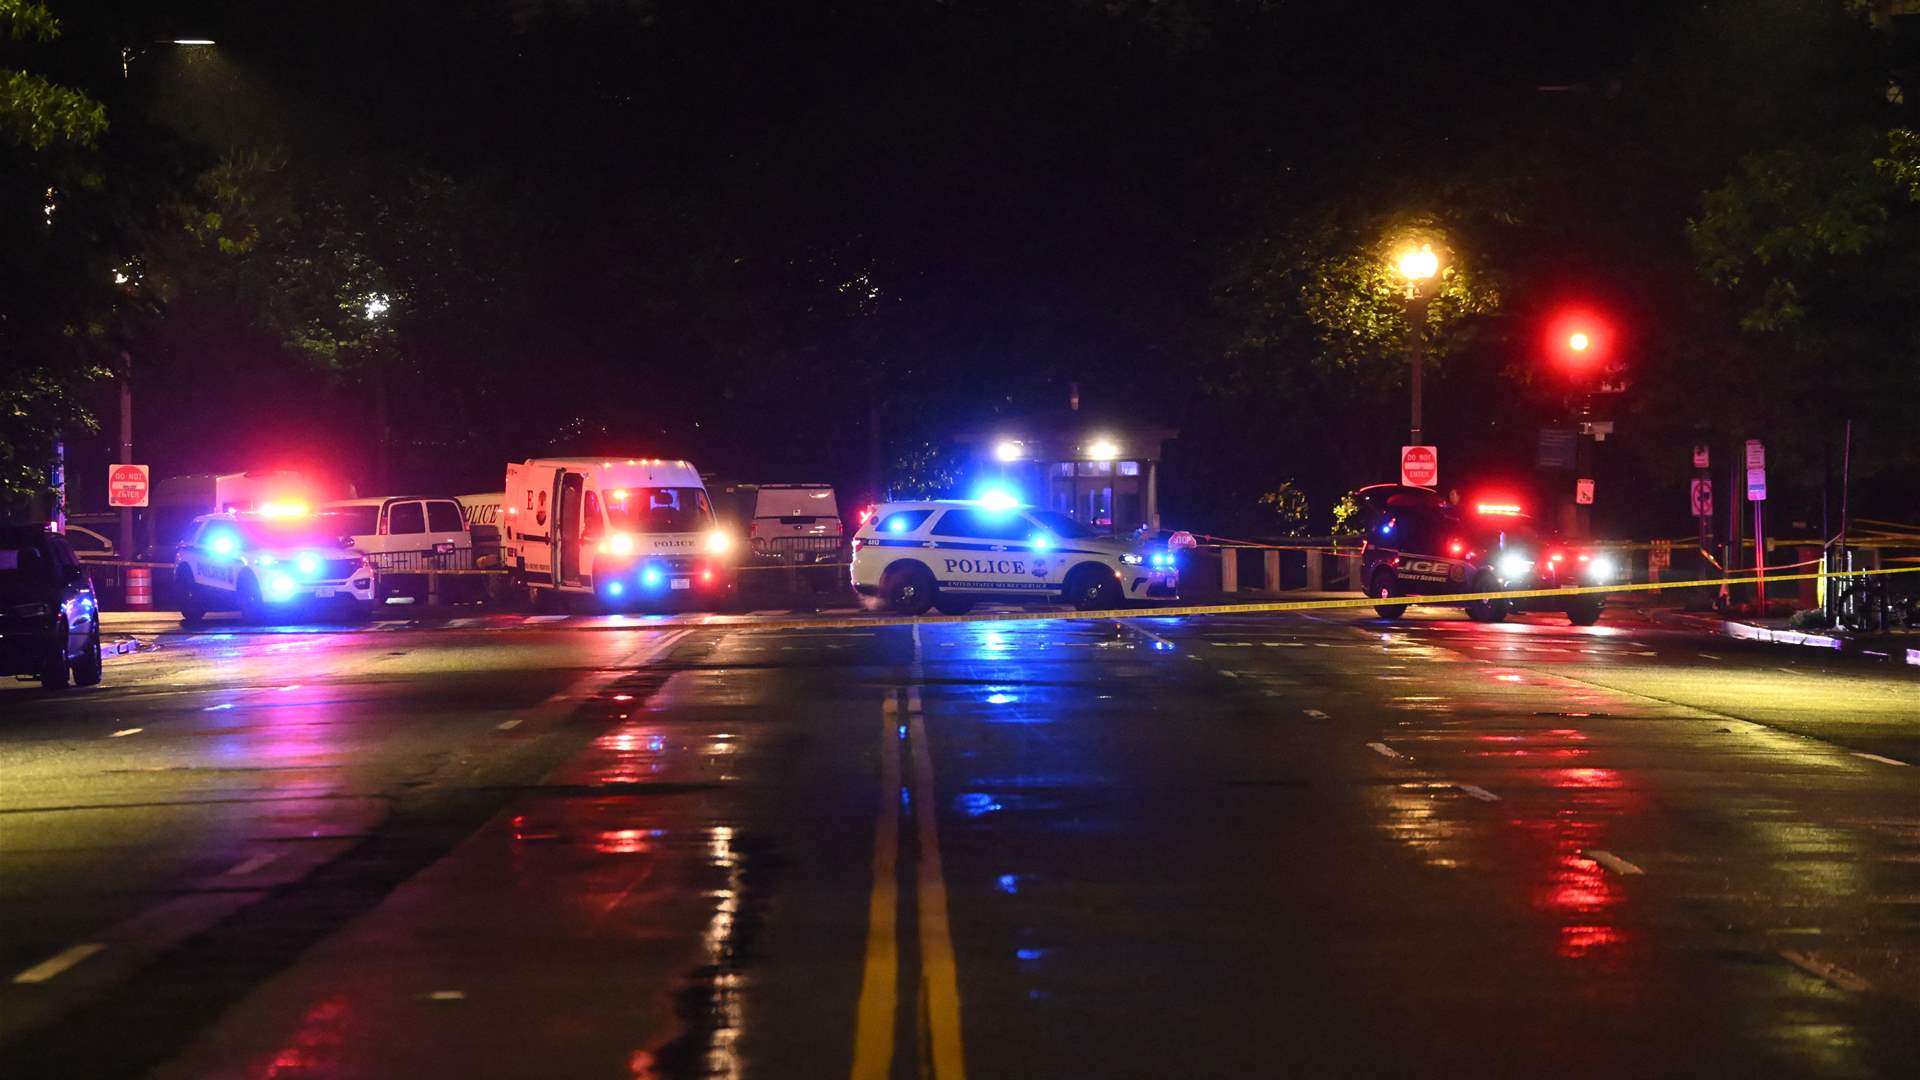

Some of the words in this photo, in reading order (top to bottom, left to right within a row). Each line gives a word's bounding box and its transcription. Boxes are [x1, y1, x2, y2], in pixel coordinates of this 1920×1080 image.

[115, 472, 125, 481] DO
[128, 472, 142, 481] NOT
[527, 490, 534, 510] E
[654, 540, 695, 548] POLICE
[1173, 536, 1191, 545] STOP
[944, 559, 1025, 574] POLICE
[1397, 561, 1449, 574] ICE
